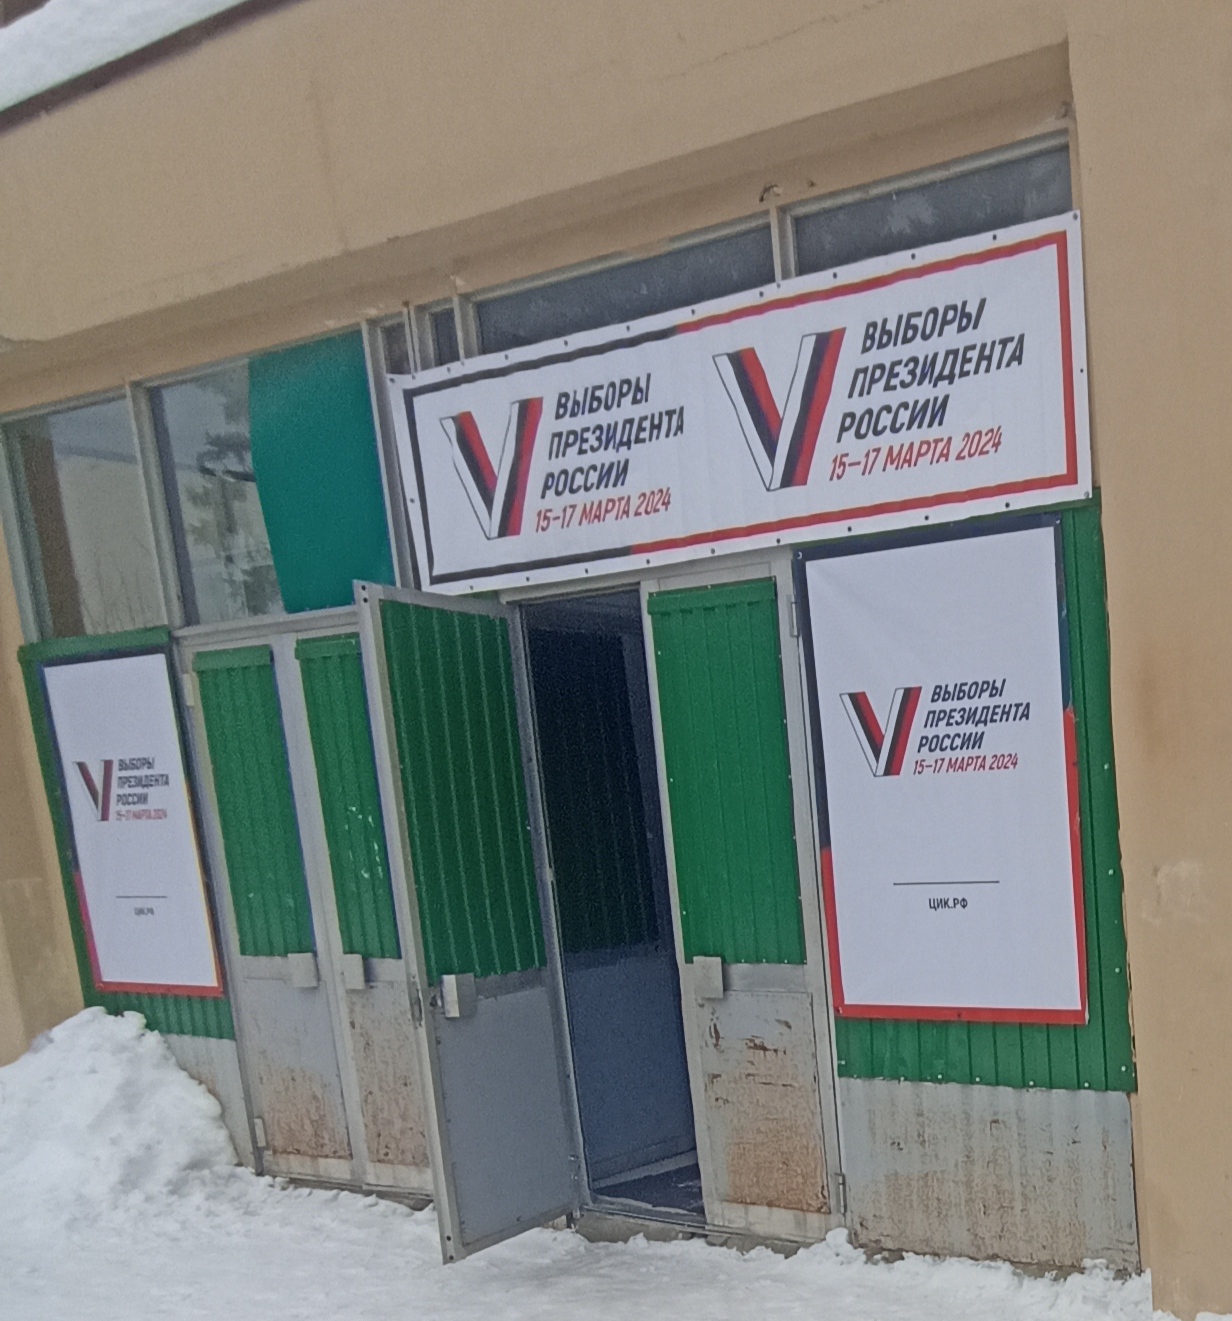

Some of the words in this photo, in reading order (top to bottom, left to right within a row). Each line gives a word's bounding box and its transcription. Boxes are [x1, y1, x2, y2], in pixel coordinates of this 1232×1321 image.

[861, 297, 988, 354] ВЫБОРЫ
[847, 333, 1025, 399] ПРЕЗИДЕНТА
[554, 373, 652, 420] ВЫБОРЫ
[548, 406, 685, 461] ПРЕЗИДЕНТА
[836, 394, 950, 443] РОССИИ
[882, 436, 952, 472] МАРТА
[955, 426, 1002, 461] 2024
[540, 458, 630, 499] РОССИИ
[578, 495, 632, 526] МАРТА
[634, 487, 671, 517] 2024
[930, 678, 1006, 703] ВЫБОРЫ
[923, 702, 1031, 729] ПРЕЗИДЕНТА
[917, 731, 985, 753] РОССИИ
[117, 757, 155, 771] ВЫБОРЫ
[946, 755, 987, 773] МАРТА
[989, 753, 1018, 770] 2024
[117, 773, 170, 789] ПРЕЗИДЕНТА
[116, 792, 149, 806] РОССИИ
[928, 897, 968, 912] ЦИК.РФ
